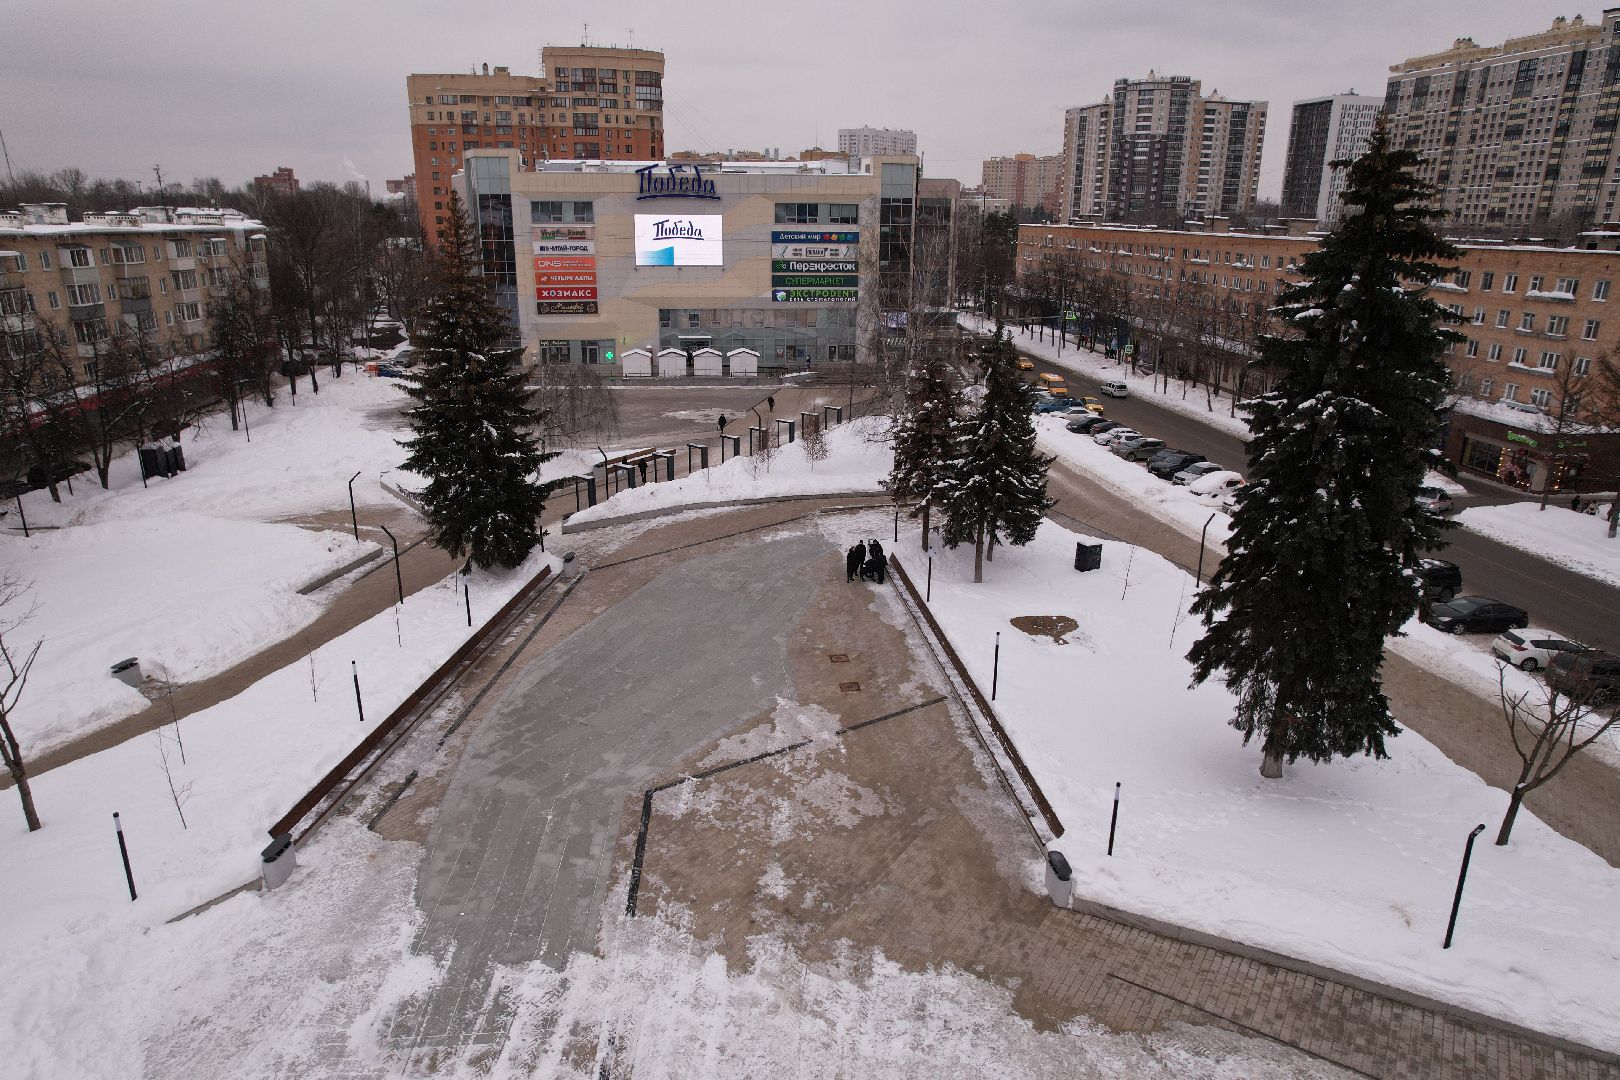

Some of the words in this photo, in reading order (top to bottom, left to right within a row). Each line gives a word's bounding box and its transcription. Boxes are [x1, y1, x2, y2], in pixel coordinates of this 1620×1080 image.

[635, 163, 716, 195] Победа
[653, 219, 703, 238] Победа
[538, 260, 561, 268] DNS
[789, 261, 856, 272] Перекресток
[785, 277, 845, 285] СУПЕРМАРКЕТ
